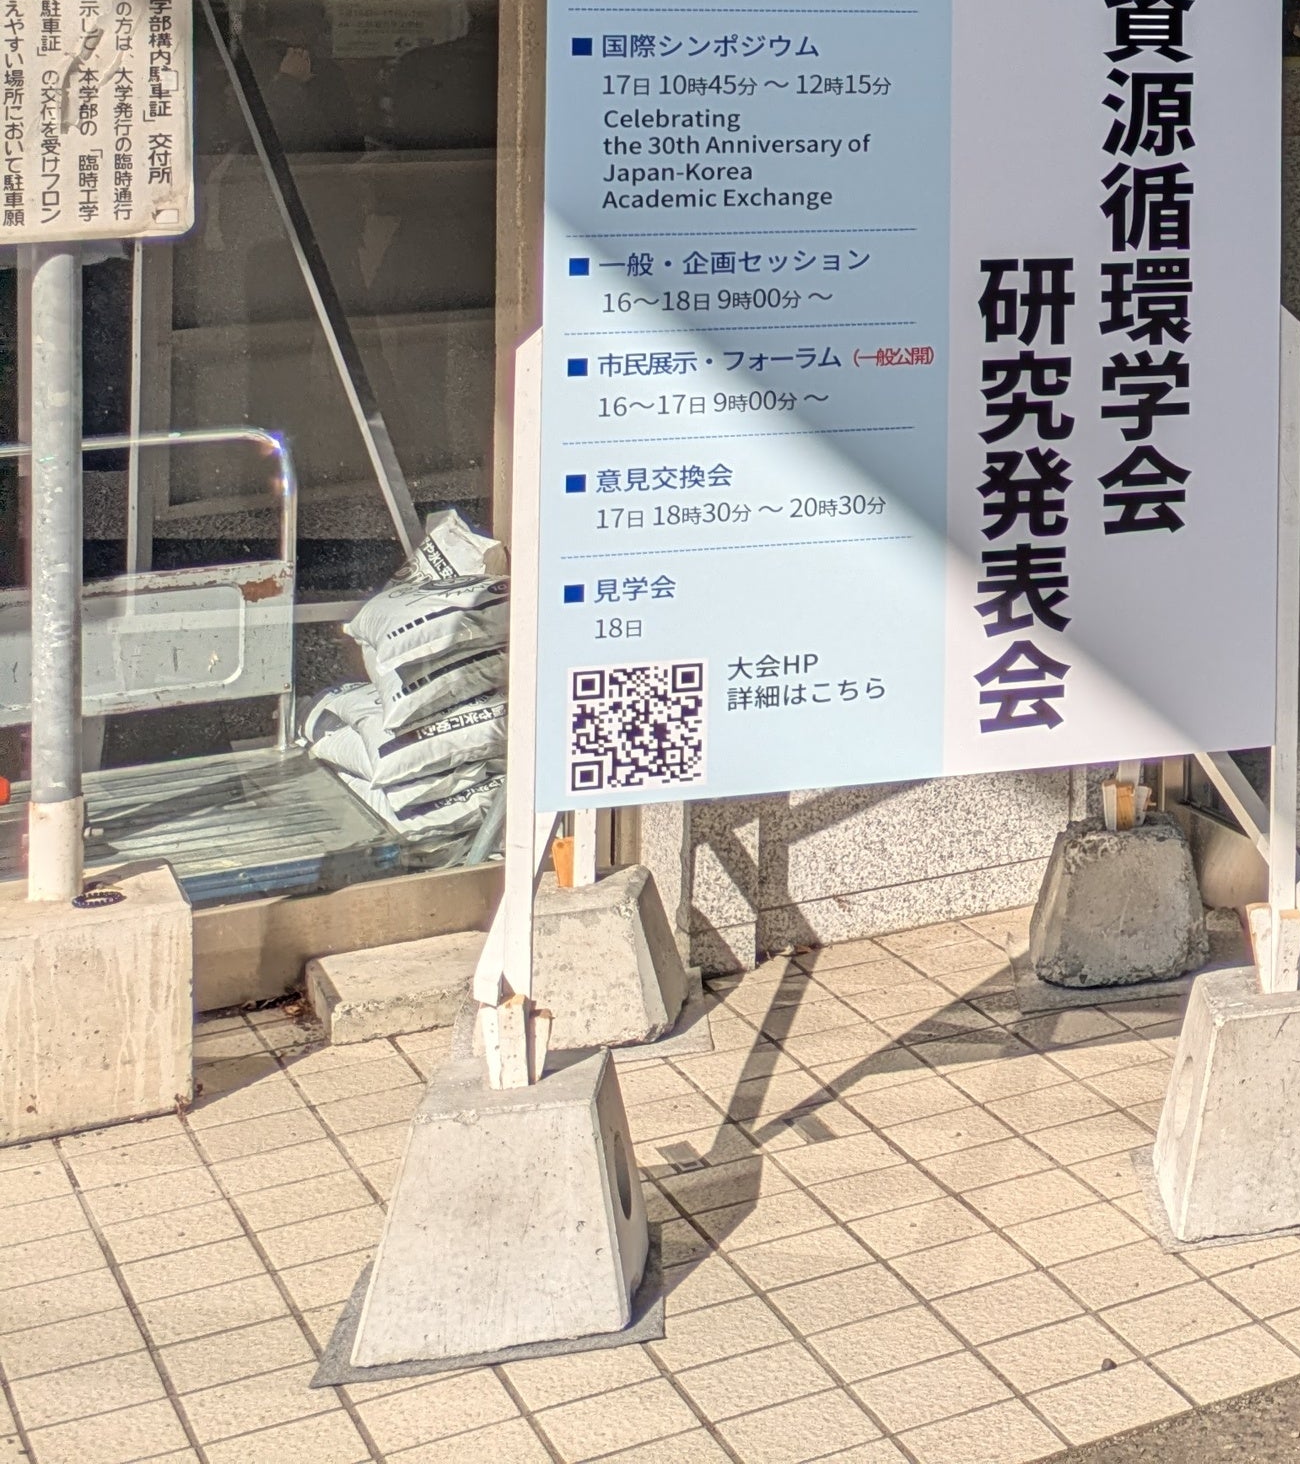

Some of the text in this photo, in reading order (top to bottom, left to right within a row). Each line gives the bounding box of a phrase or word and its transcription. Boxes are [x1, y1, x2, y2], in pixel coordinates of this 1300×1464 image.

[601, 33, 820, 59] 国際シンポジウム
[603, 107, 741, 133] Celebrating
[603, 133, 872, 159] the 30th Anniversary of
[602, 161, 754, 187] Japan-Korea
[601, 187, 834, 212] Academic Exchange
[598, 248, 871, 278] 一般・企画セッション
[597, 346, 843, 378] 市民展示・フォーラム
[595, 462, 735, 495] 意見交換会
[973, 257, 1076, 736] 研究発表会
[593, 573, 678, 605] 見学会
[593, 617, 644, 640] 18日
[726, 652, 820, 682] 大会HP
[726, 676, 888, 713] 詳細はこちら
